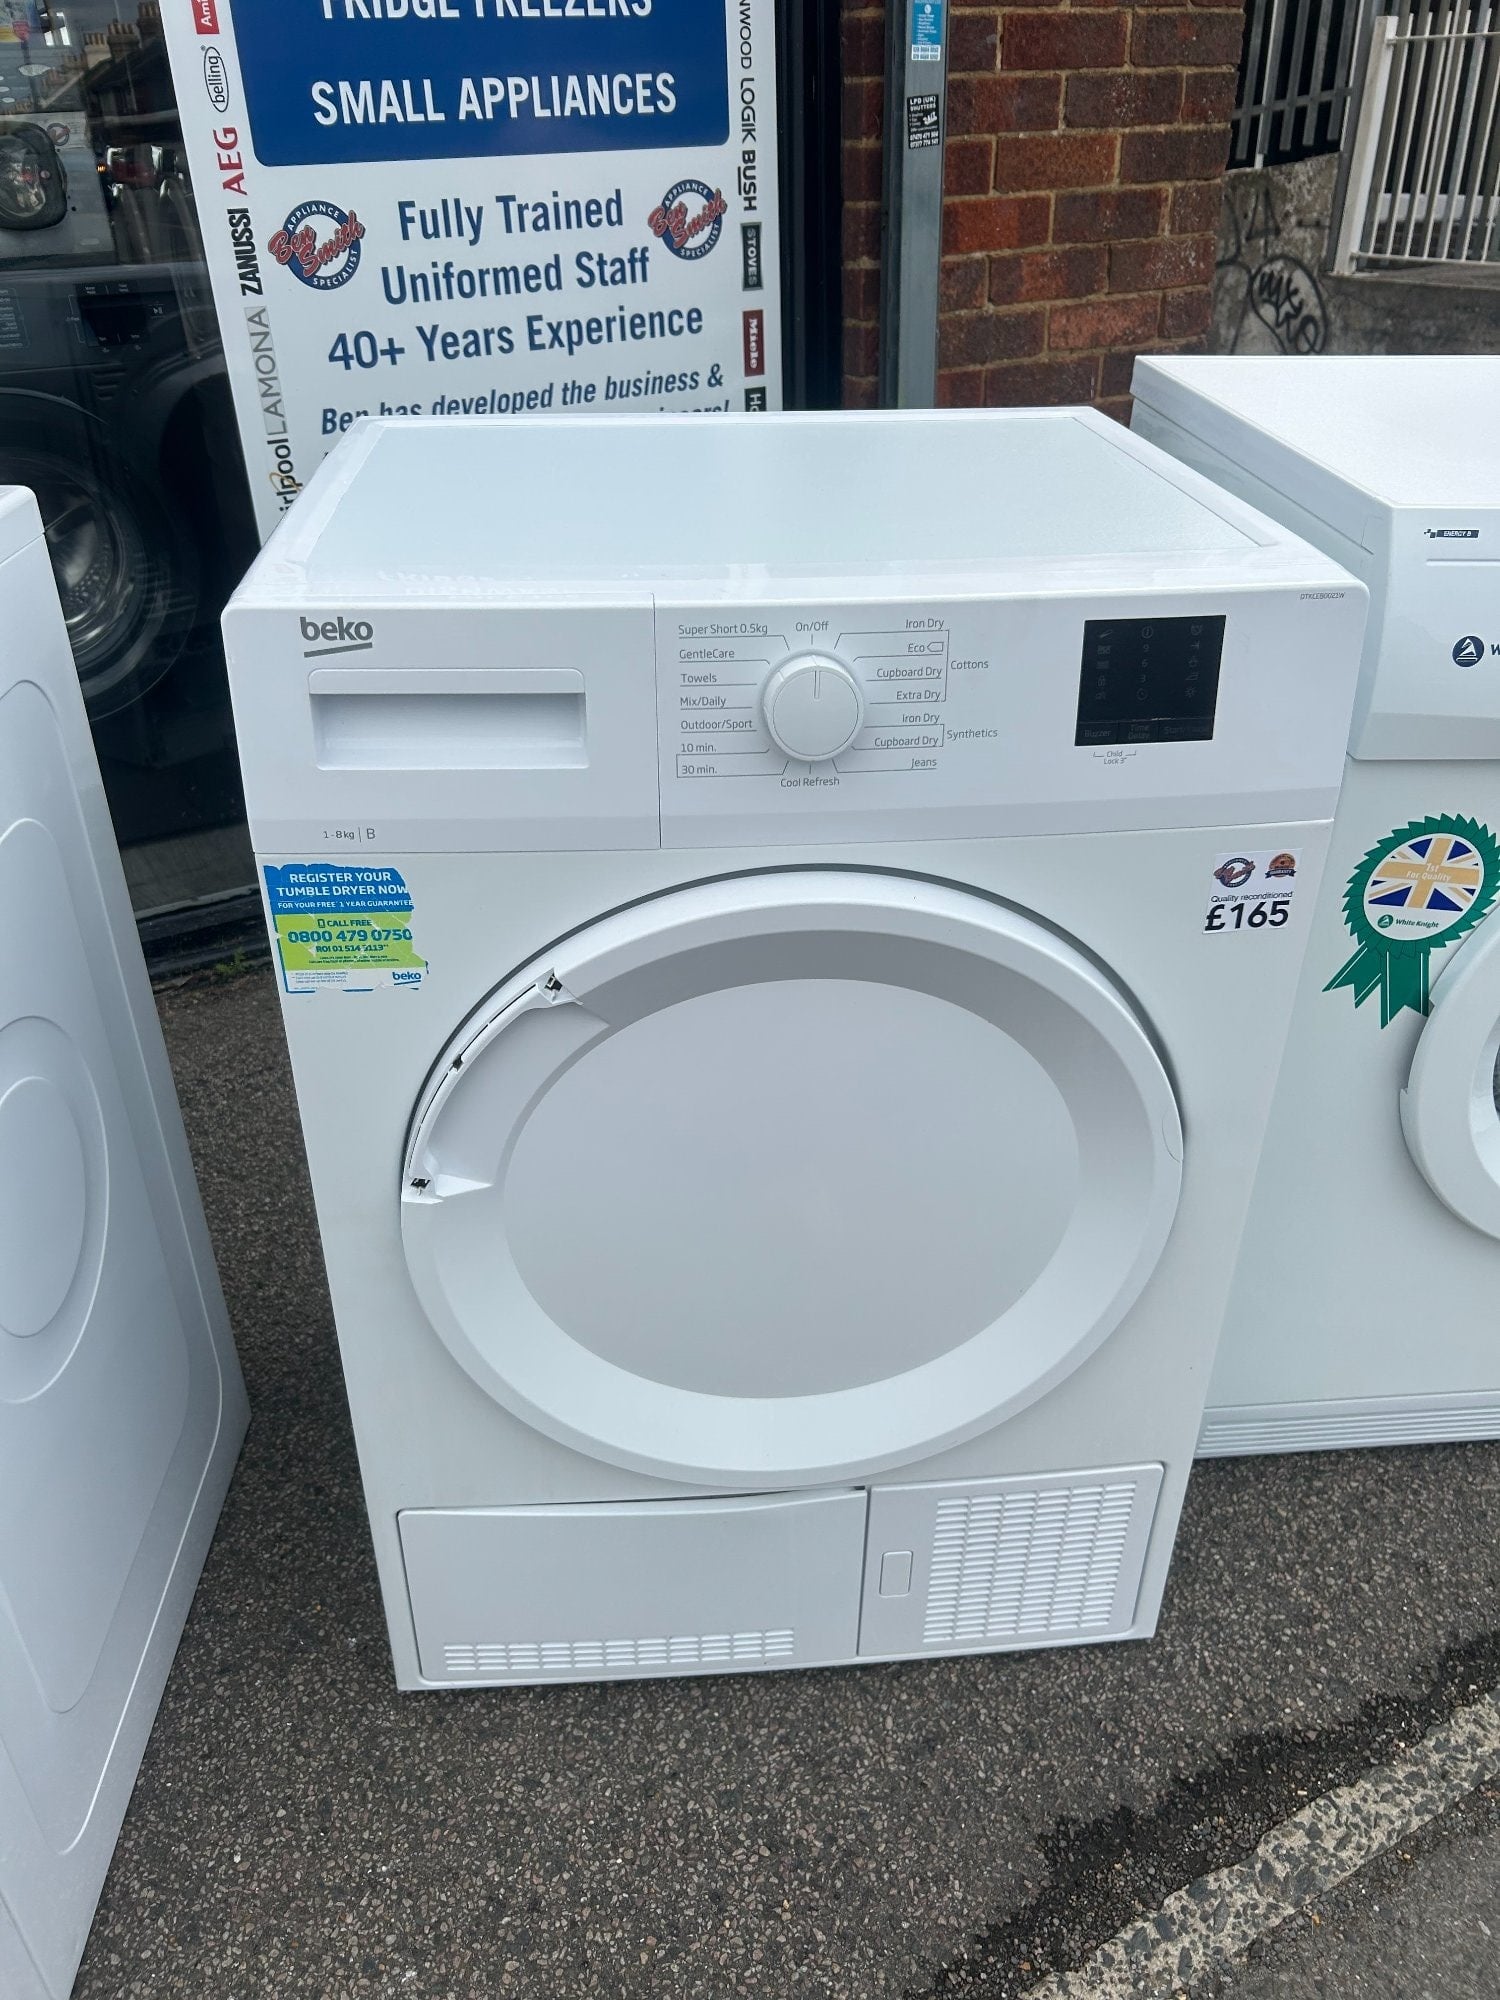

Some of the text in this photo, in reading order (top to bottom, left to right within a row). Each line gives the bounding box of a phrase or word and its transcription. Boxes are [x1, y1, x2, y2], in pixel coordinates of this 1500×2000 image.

[207, 55, 226, 103] belling
[311, 72, 677, 125] SMALL APPLIANCES
[740, 77, 757, 144] LOGIK
[213, 127, 247, 196] AEG
[741, 150, 757, 211] BUSH
[665, 183, 709, 208] APPLIANCE
[287, 204, 340, 231] APPLIANCE
[398, 188, 624, 246] Fully Trained
[648, 201, 688, 237] Ben
[671, 187, 728, 249] Smith
[268, 225, 316, 265] Ben
[298, 209, 366, 277] Smith
[680, 223, 721, 257] SPECIALIST
[227, 208, 263, 296] ZANUSSI
[745, 227, 759, 286] STOVES
[312, 249, 358, 287] SPECIALIST
[381, 246, 650, 305] Uniformed Staff
[327, 305, 704, 371] 40+ Years Experience
[748, 318, 759, 369] Miele
[246, 306, 288, 436] LAMONA
[431, 382, 554, 415] developed
[561, 379, 596, 406] the
[605, 369, 700, 401] business
[707, 363, 724, 388] &
[300, 616, 373, 641] beko
[678, 623, 768, 636] Super Short 0.5kg
[795, 620, 830, 632] On/Off
[905, 618, 945, 630] Iron Dry
[679, 649, 735, 659] GentleCare
[907, 643, 925, 652] Eco
[950, 660, 989, 670] Cottons
[680, 673, 717, 683] Towels
[876, 667, 943, 679] Cupboard Dry
[680, 696, 727, 707] Mix/Daily
[896, 690, 941, 702] Extra Dry
[680, 719, 753, 730] Outdoor/Sport
[902, 713, 940, 725] Iron Dry
[946, 729, 998, 740] Synthetics
[681, 743, 717, 752] 10 min.
[874, 736, 939, 748] Cupboard Dry
[911, 758, 937, 768] Jeans
[1103, 757, 1119, 765] Lock
[681, 764, 718, 774] 30 min.
[780, 776, 840, 787] Cool Refresh
[323, 828, 376, 841] 1-8kg B
[1426, 863, 1439, 873] 1st
[289, 872, 391, 883] REGISTER YOUR
[1406, 871, 1451, 882] For Quality
[276, 884, 408, 897] TUMBLE DRYER NOW
[1241, 891, 1293, 900] reconditioned
[1205, 900, 1290, 931] £165
[1416, 920, 1439, 929] Knight
[288, 929, 412, 943] 0800 479 0750
[316, 945, 331, 953] ROI
[333, 945, 344, 953] 01
[345, 945, 361, 953] 514
[392, 971, 422, 980] beko
